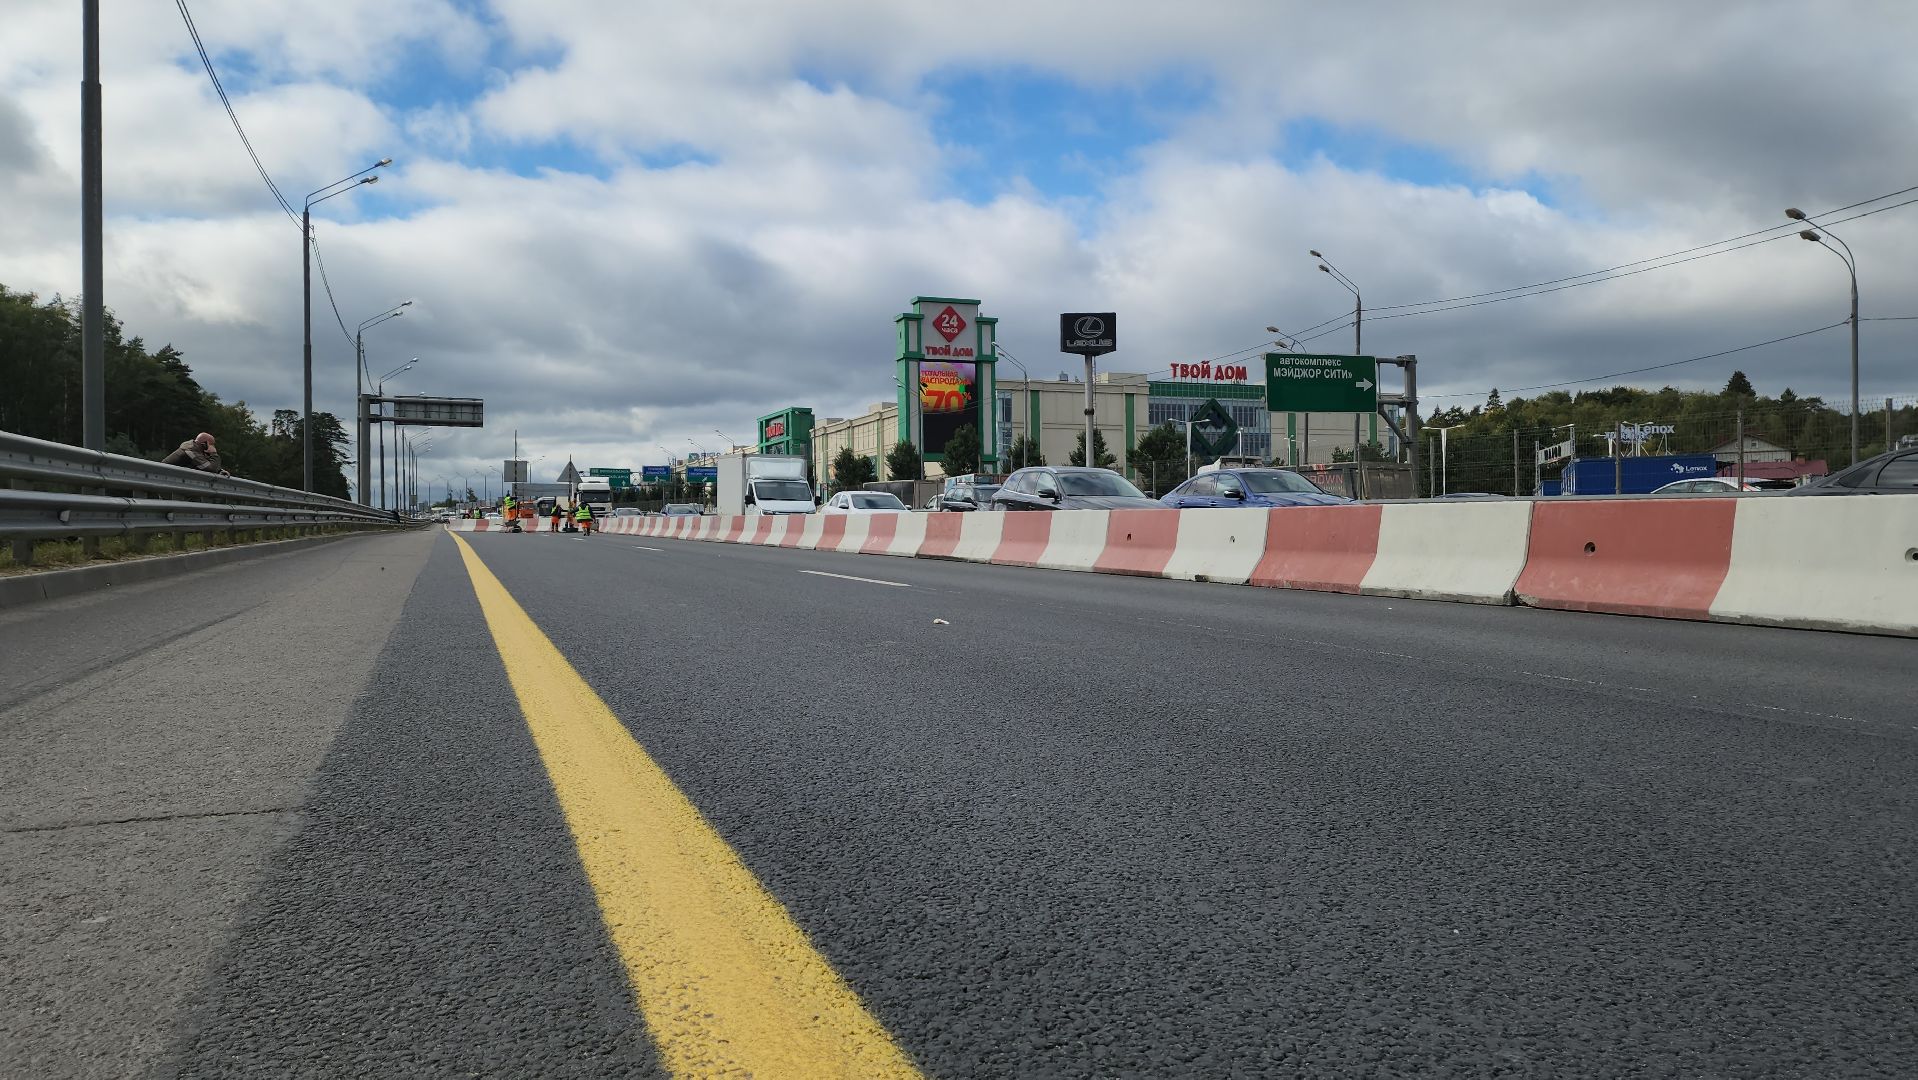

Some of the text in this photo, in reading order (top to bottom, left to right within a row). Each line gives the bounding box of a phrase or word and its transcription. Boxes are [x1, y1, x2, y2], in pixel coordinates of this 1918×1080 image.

[941, 314, 958, 327] 24
[1066, 338, 1113, 347] LEXUS
[925, 345, 974, 357] ТВОЙ ДОМ
[1279, 357, 1342, 366] автокомплекс
[1170, 360, 1248, 380] ТВОЙ ДОМ
[1273, 366, 1353, 379] МЭЙДЖОР СИТИ»
